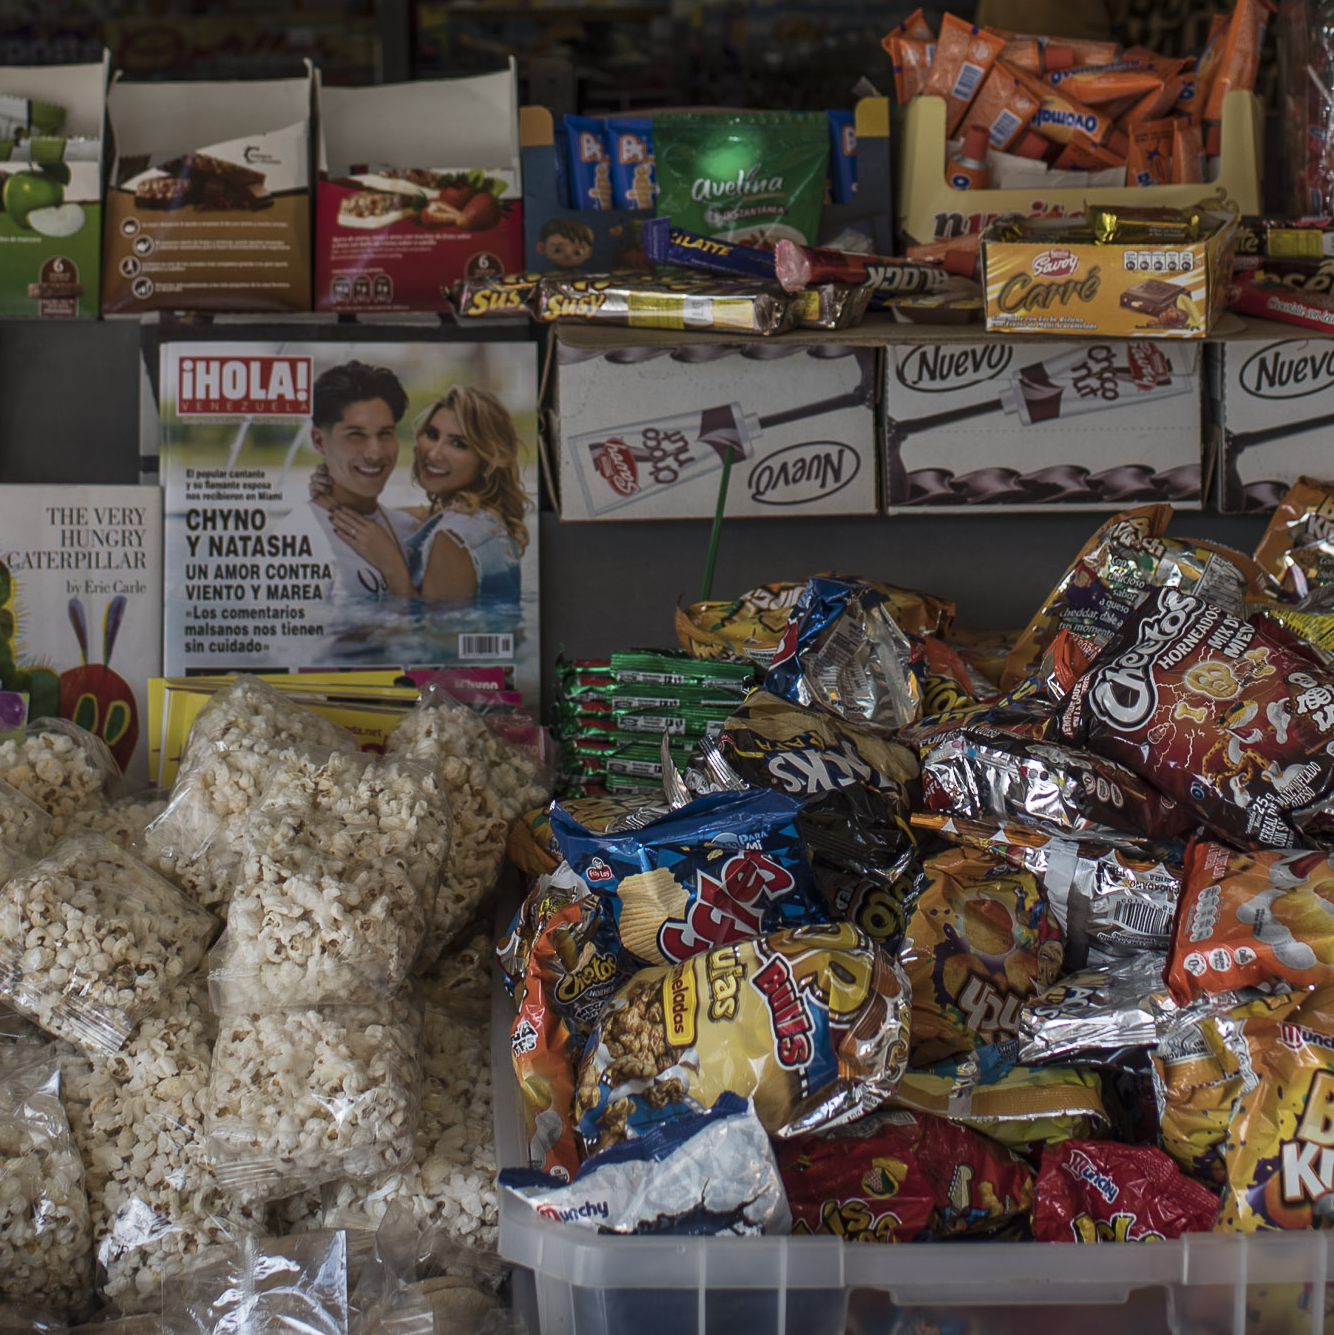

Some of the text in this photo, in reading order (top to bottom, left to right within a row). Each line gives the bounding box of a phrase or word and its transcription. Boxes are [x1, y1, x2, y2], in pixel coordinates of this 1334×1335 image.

[182, 360, 308, 401] ¡HOLA!
[46, 508, 146, 526] THE VERY
[186, 509, 266, 530] CHYNO
[60, 529, 146, 550] HUNGRY
[187, 535, 312, 557] Y NATASHA
[6, 551, 147, 570] CATERPILLAR
[186, 564, 332, 580] UN AMOR CONTRA
[186, 585, 322, 600] VIENTO Y MAREA
[222, 606, 305, 619] comentarios
[185, 623, 323, 635] malsanos nos tienen
[185, 639, 204, 653] sin
